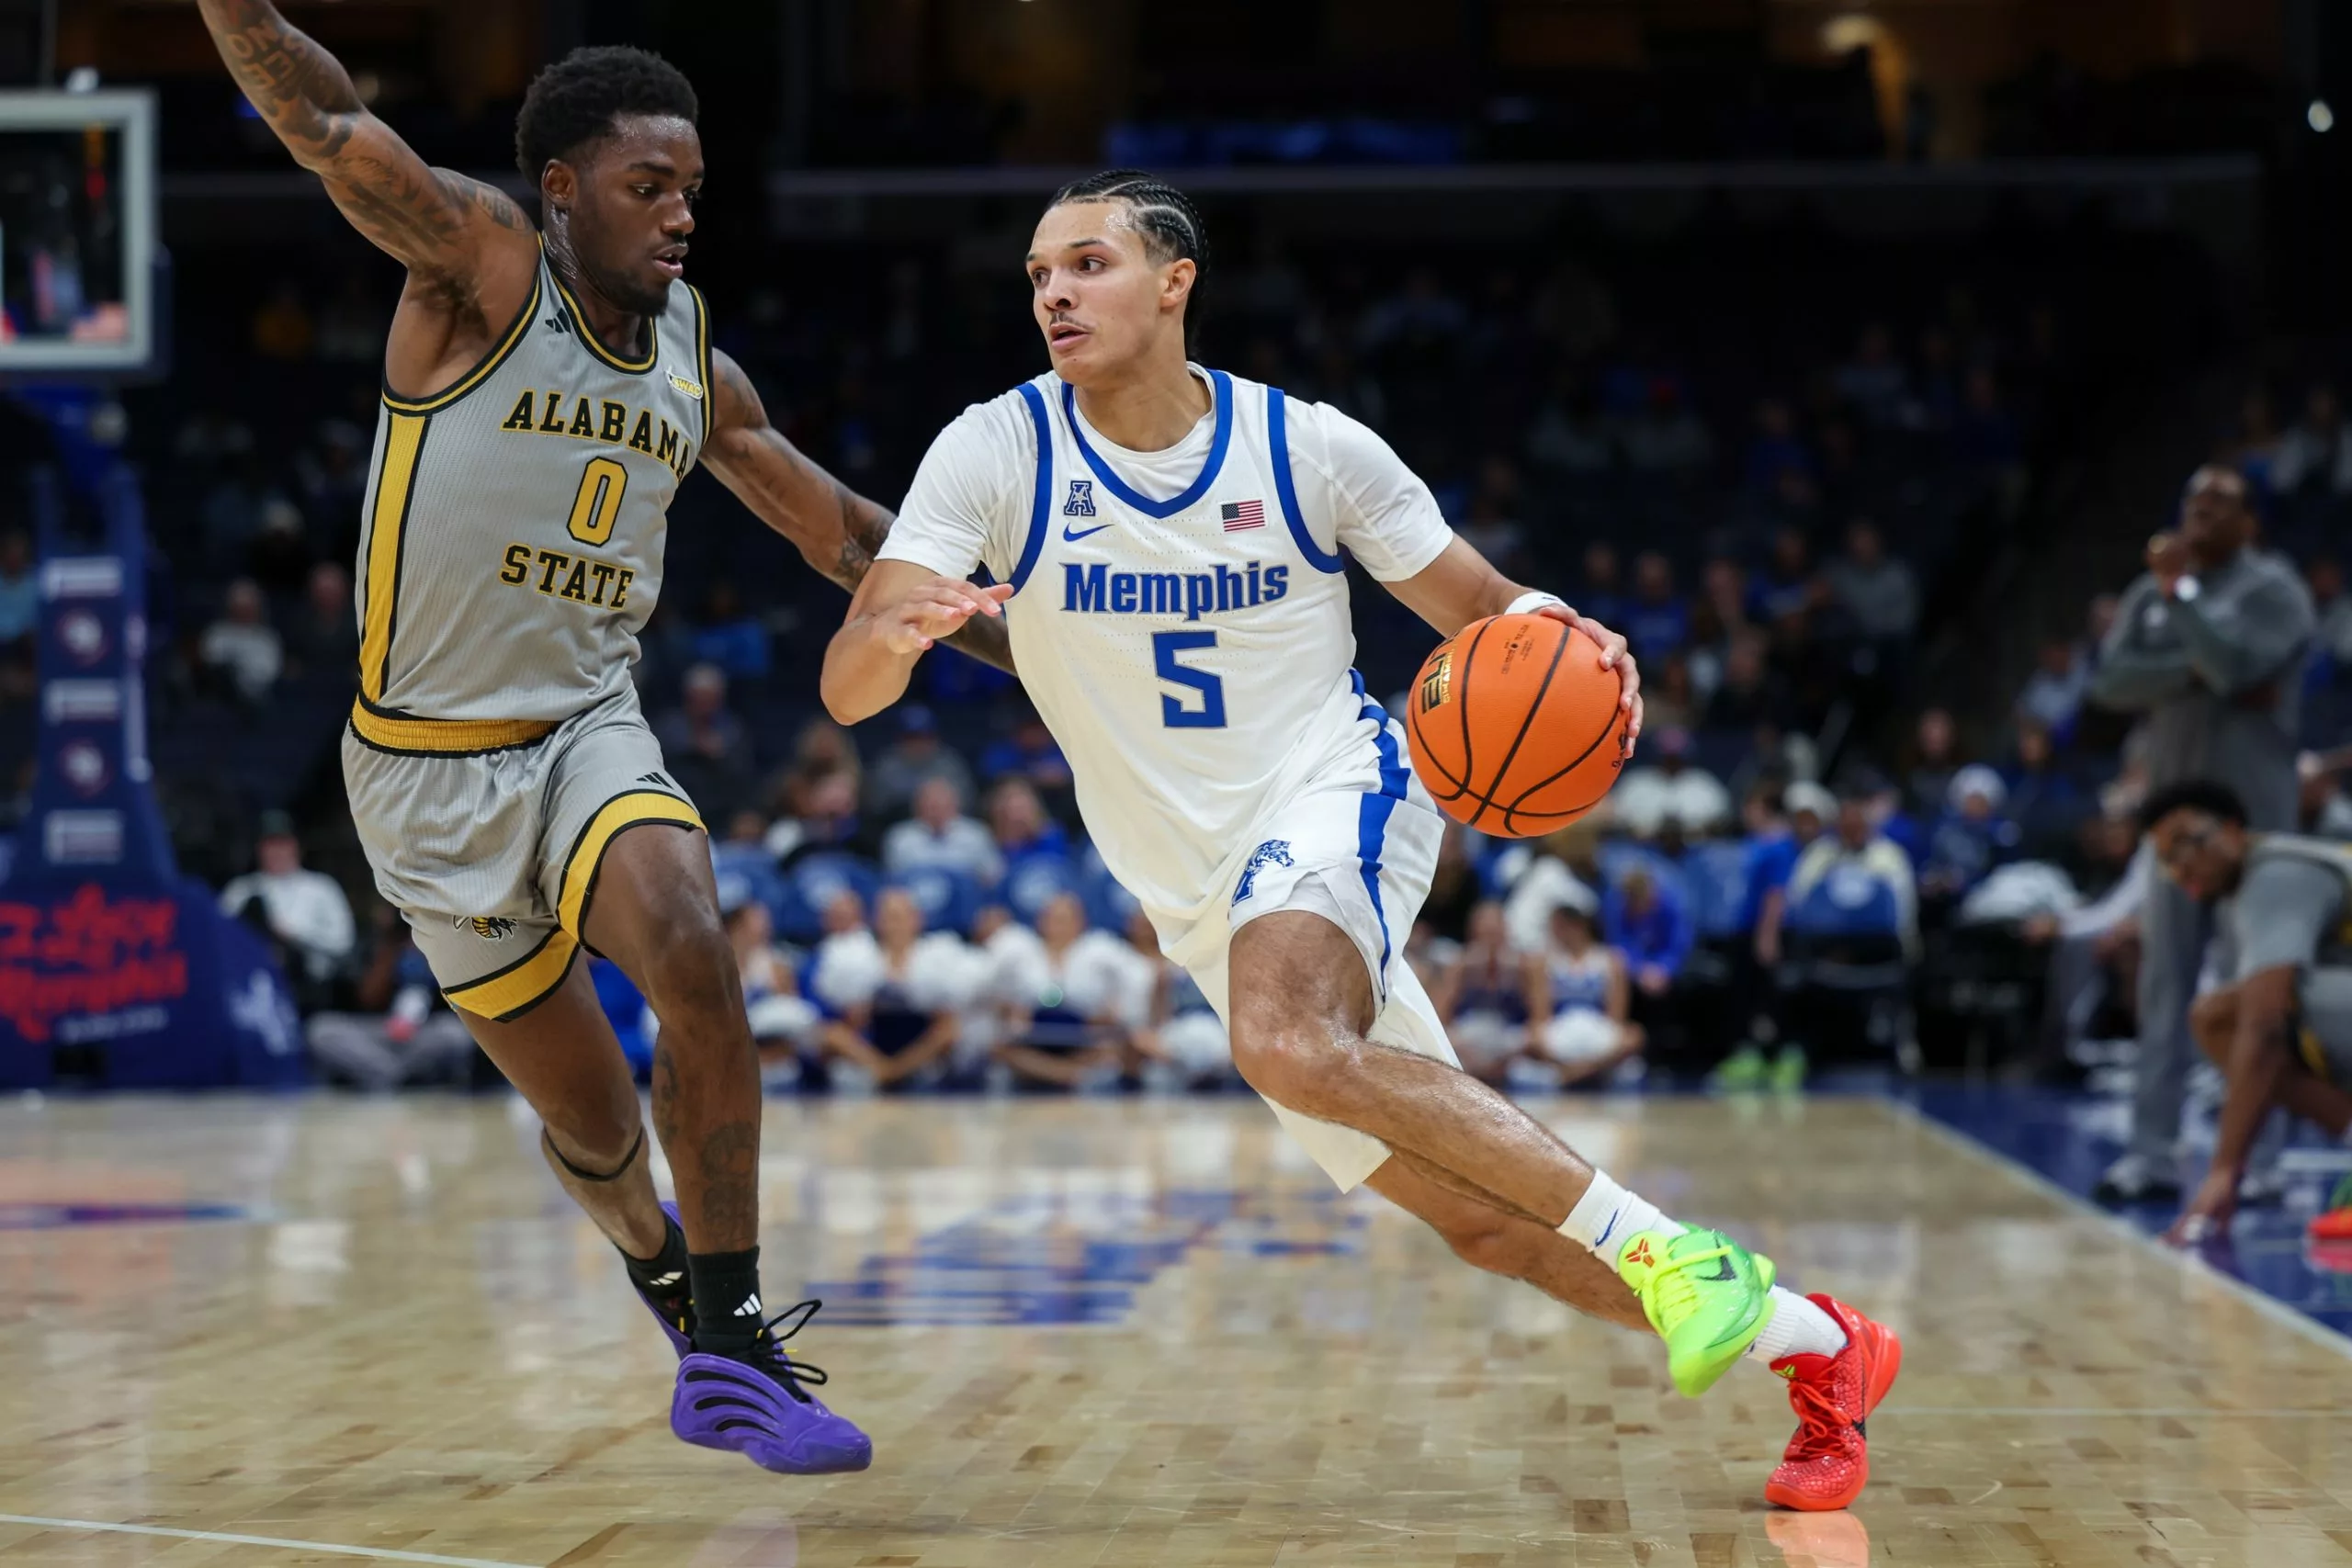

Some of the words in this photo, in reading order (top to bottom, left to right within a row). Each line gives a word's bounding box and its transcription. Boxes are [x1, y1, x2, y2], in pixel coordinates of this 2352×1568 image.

[500, 388, 690, 482] ALABAMA
[566, 456, 628, 547] 0
[500, 542, 638, 611] STATE
[1057, 559, 1289, 622] Memphis
[1150, 629, 1227, 728] 5
